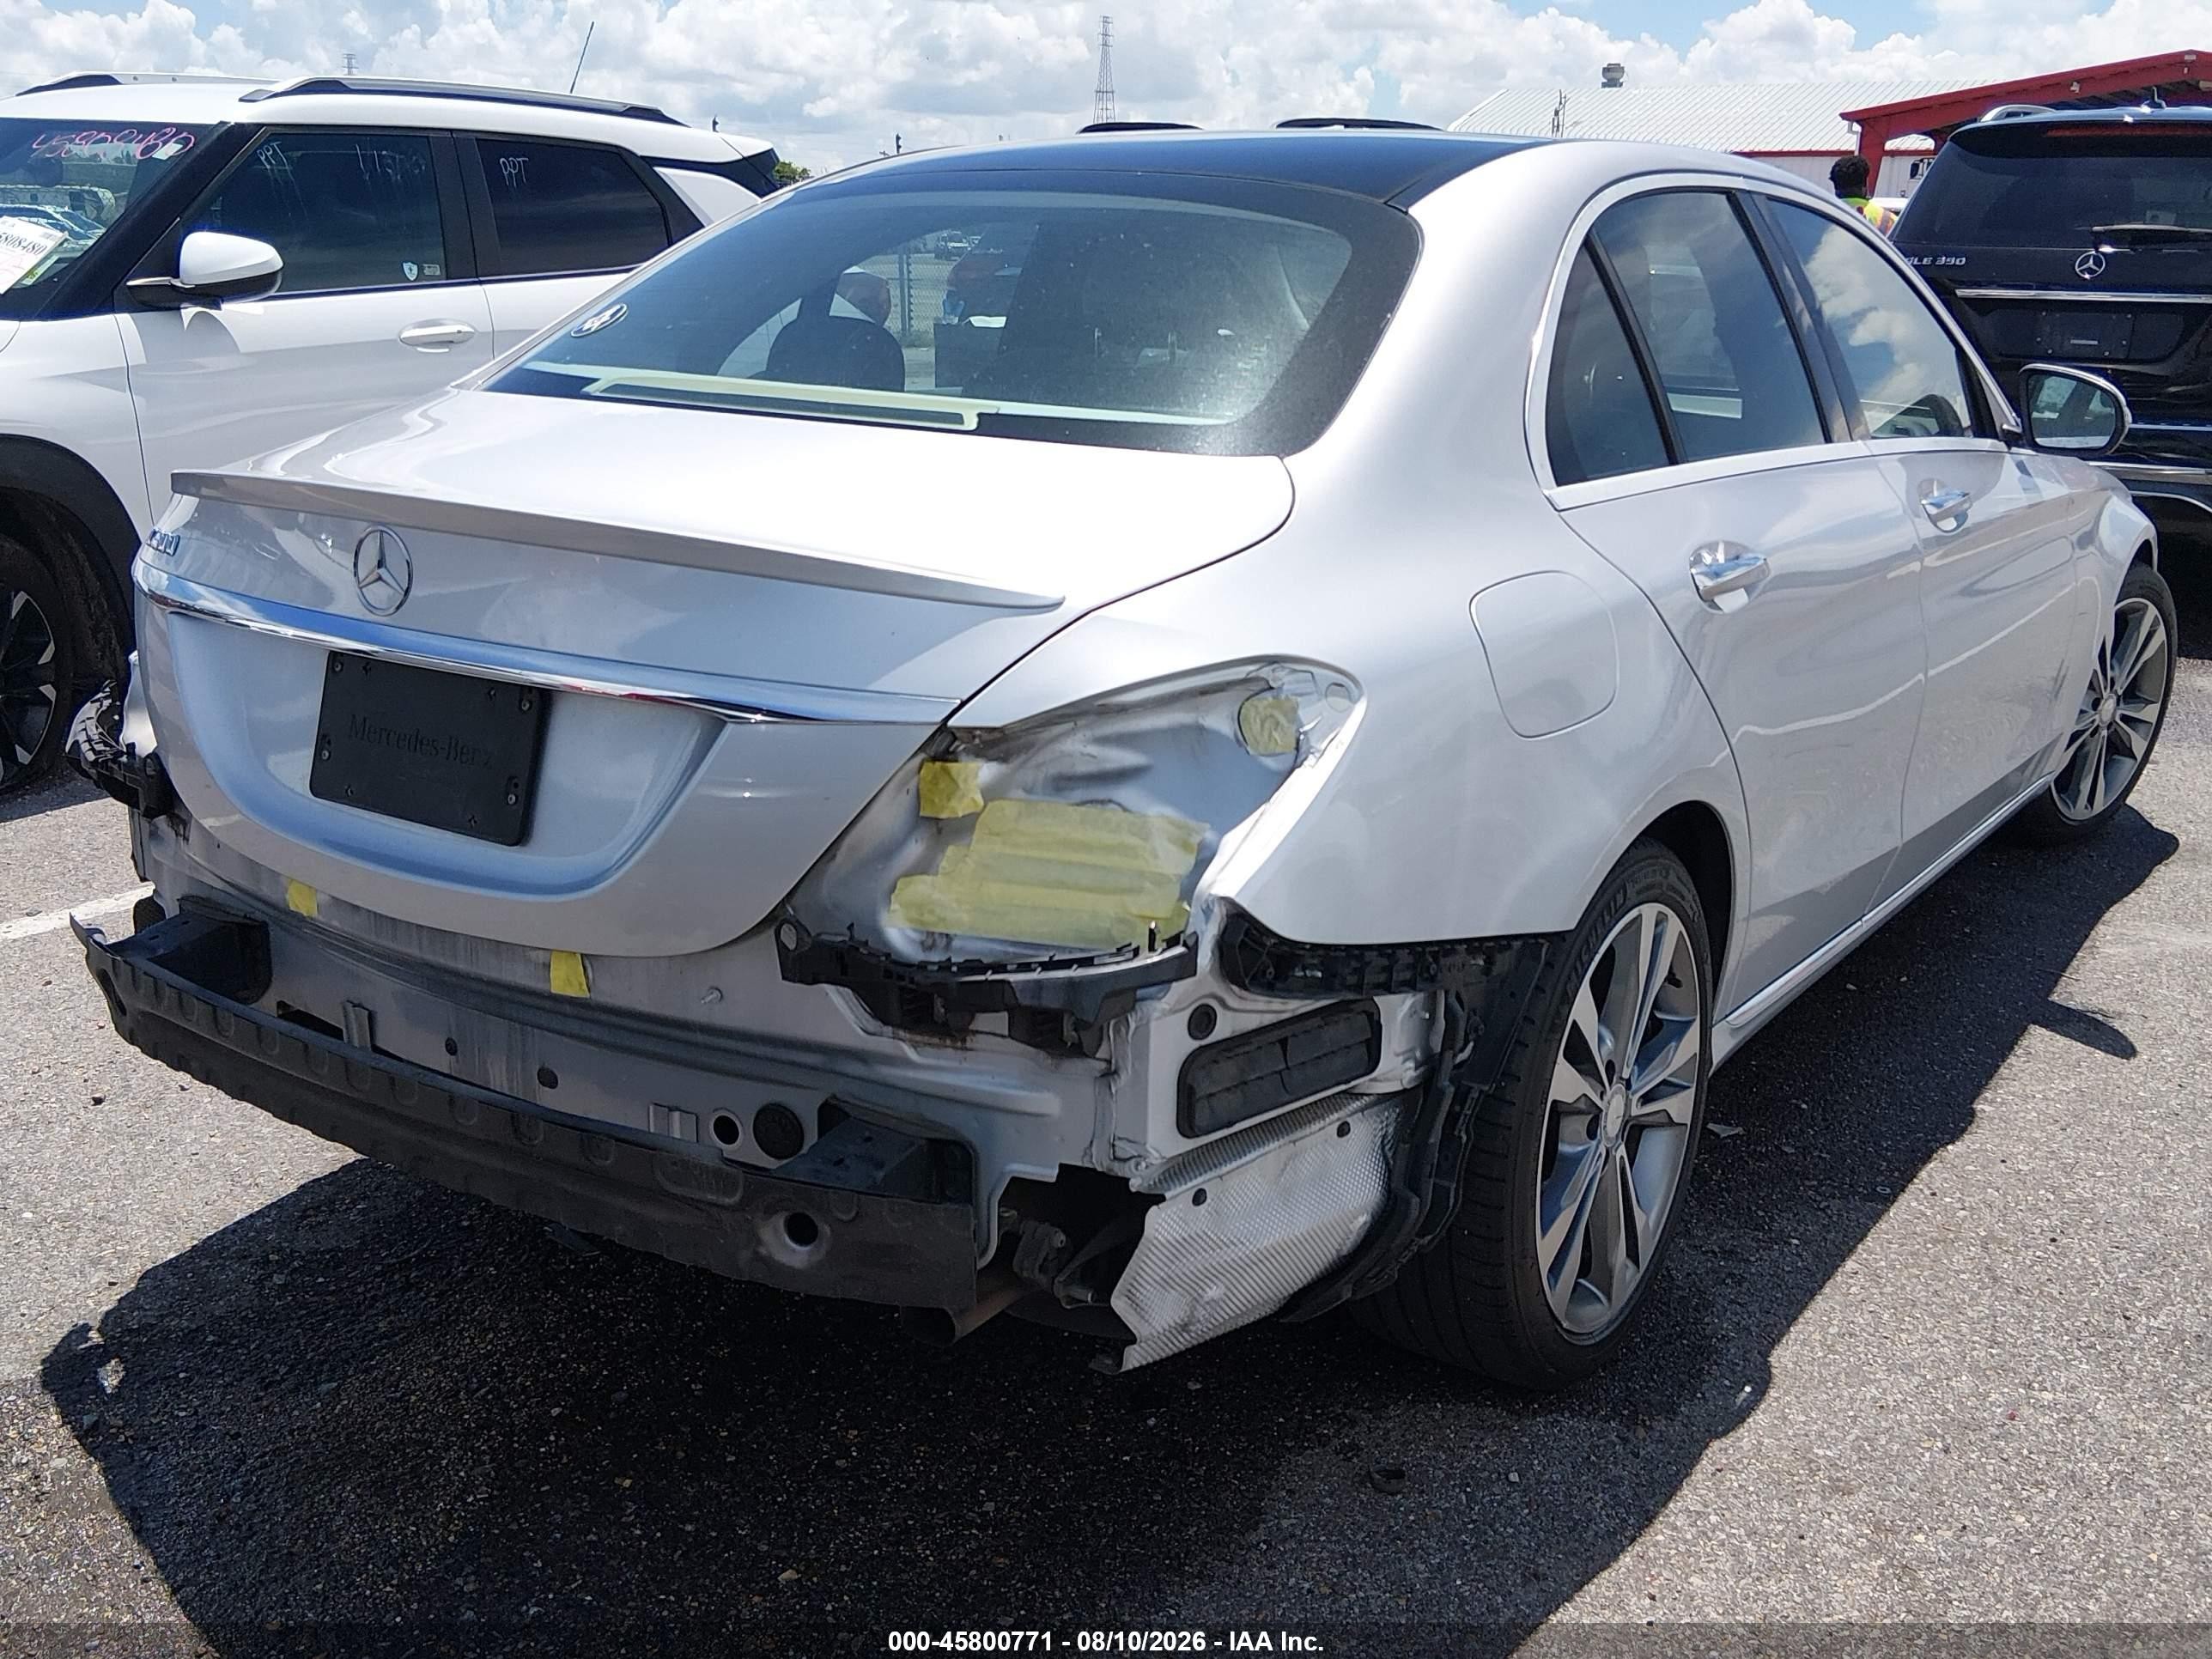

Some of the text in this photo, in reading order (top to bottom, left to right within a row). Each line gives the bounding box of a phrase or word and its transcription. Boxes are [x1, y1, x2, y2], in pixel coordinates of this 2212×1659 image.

[257, 141, 289, 170] PPT
[499, 157, 529, 187] PPT
[348, 713, 495, 769] Mercedes-Benz
